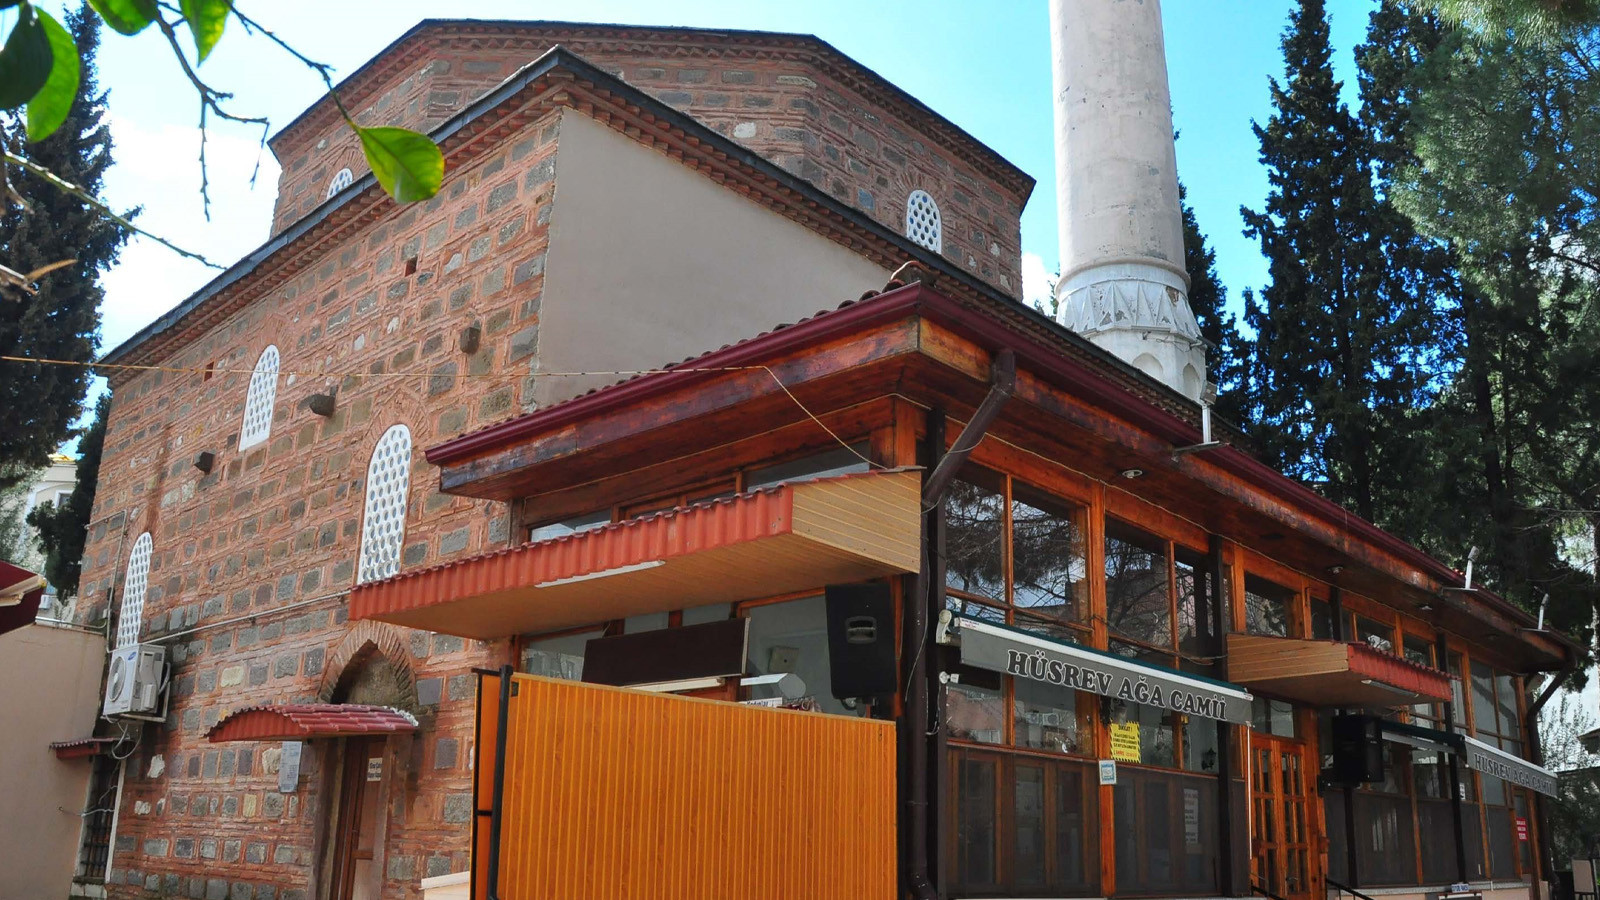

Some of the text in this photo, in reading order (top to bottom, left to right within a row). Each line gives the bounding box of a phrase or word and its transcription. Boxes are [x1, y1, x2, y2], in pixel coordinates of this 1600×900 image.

[1007, 650, 1228, 721] HÜSREV AĞA CAMİİ
[1474, 752, 1511, 781] HÜSREV
[1513, 768, 1532, 787] AĞA
